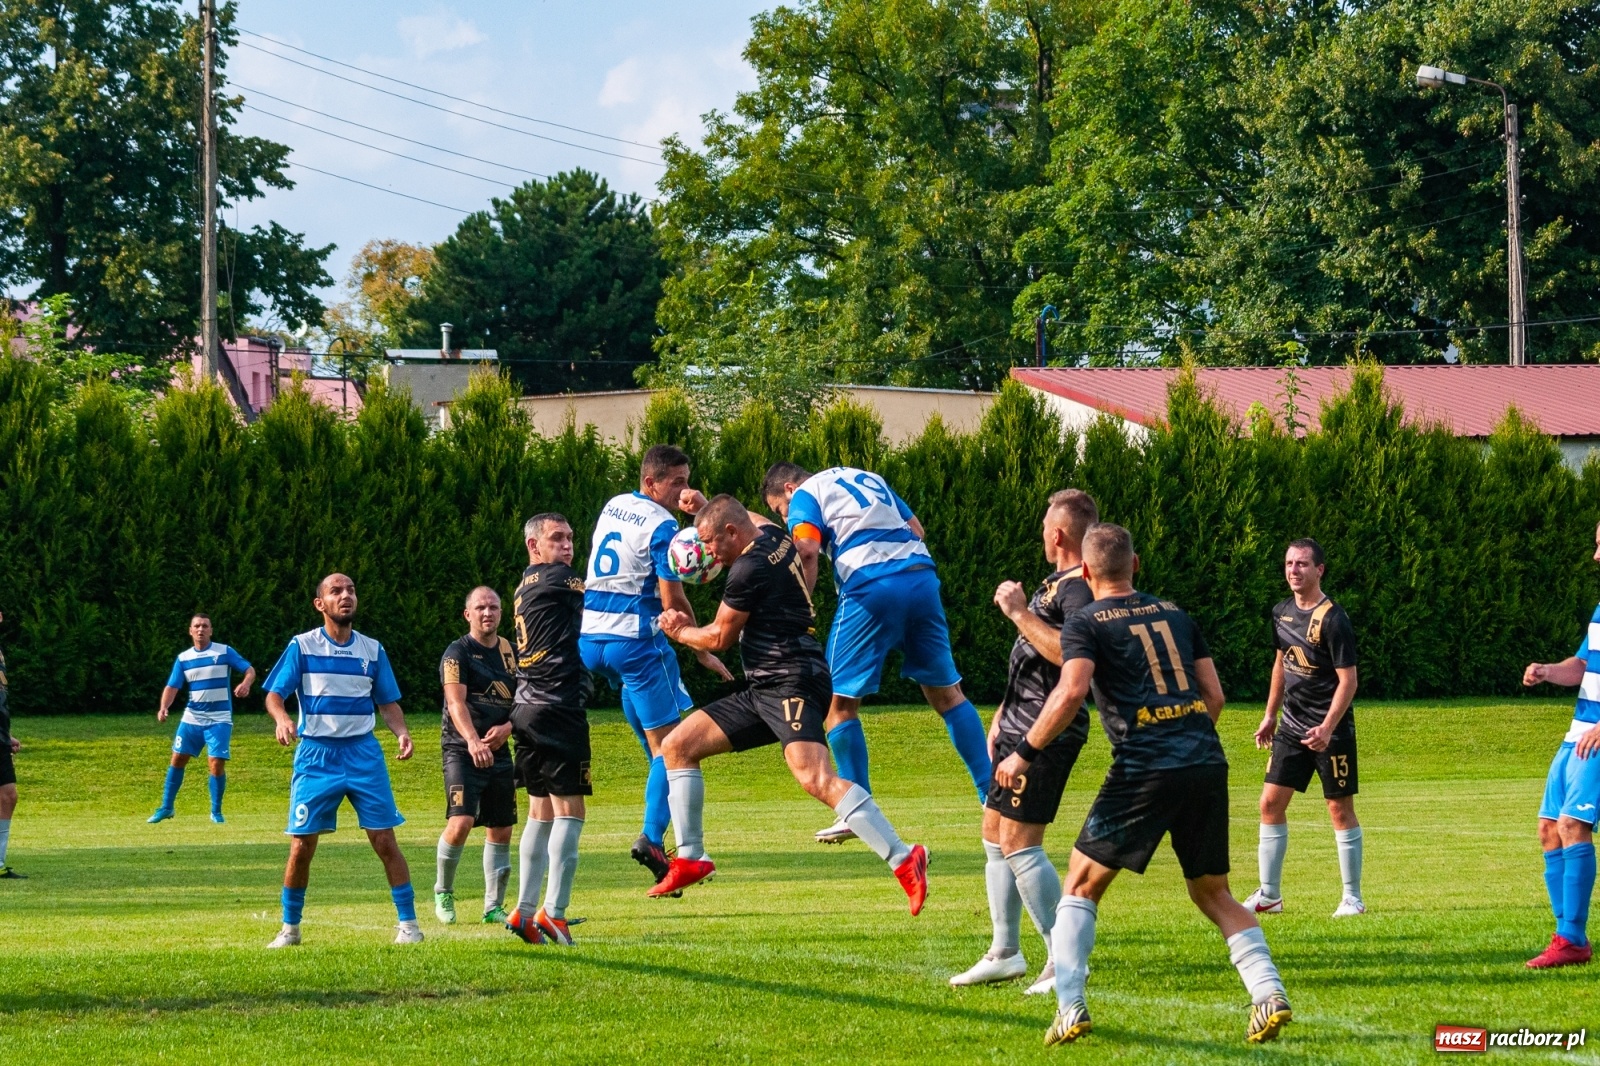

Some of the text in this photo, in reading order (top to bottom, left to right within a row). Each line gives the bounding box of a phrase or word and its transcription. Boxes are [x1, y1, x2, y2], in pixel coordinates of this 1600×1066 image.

[835, 473, 893, 509] 19
[602, 504, 647, 527] HAŁUPKI
[594, 531, 622, 578] 6
[1128, 619, 1189, 695] 11
[781, 698, 805, 722] 17
[174, 735, 183, 749] 8
[1330, 755, 1349, 779] 13
[294, 804, 309, 826] 9
